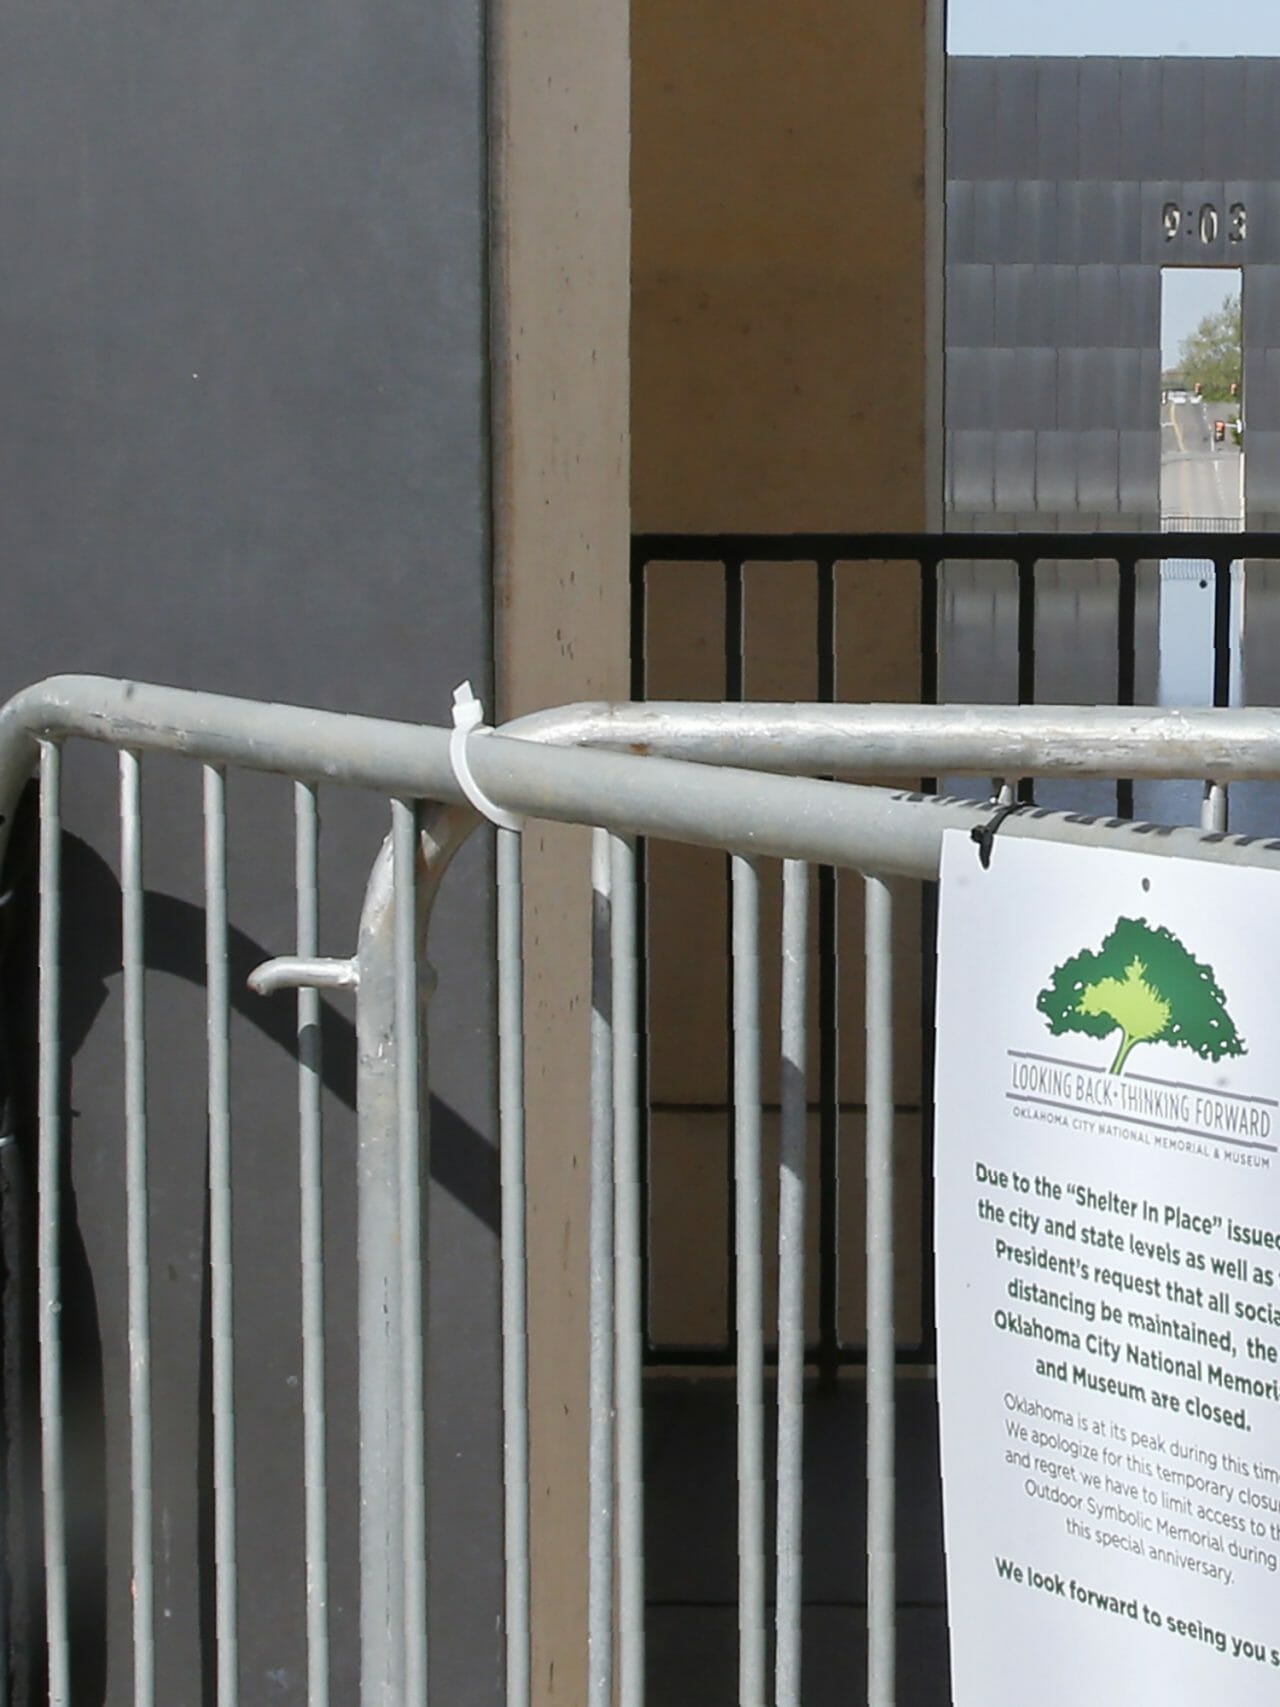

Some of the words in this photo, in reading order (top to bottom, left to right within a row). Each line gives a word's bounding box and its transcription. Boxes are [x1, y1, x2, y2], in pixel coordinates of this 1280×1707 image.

[1162, 202, 1247, 245] 9:03
[1013, 1062, 1071, 1099] LOOKING
[1196, 1098, 1270, 1138] FORWARD
[1013, 1106, 1068, 1126] OKLAHOMA
[1073, 1118, 1095, 1131] CITY
[1099, 1125, 1150, 1144] NATIONAL
[1155, 1136, 1209, 1157] MEMORIAL
[1214, 1148, 1219, 1159] &
[1224, 1150, 1269, 1168] MUSEUM
[976, 1162, 1009, 1189] Due
[1012, 1171, 1030, 1194] to
[1034, 1176, 1062, 1200] the
[1143, 1200, 1159, 1224] In
[978, 1198, 1005, 1224] the
[1009, 1207, 1040, 1235] city
[1044, 1218, 1076, 1241] and
[1080, 1226, 1124, 1252] state
[1129, 1233, 1181, 1266] levels
[1185, 1251, 1206, 1271] as
[1210, 1257, 1248, 1282] well
[1252, 1266, 1274, 1287] as
[1008, 1277, 1096, 1322] distancing
[1101, 1300, 1123, 1324] be
[1127, 1311, 1237, 1358] maintained,
[1246, 1336, 1278, 1363] the
[1094, 1267, 1161, 1298] request
[1166, 1281, 1203, 1308] that
[1208, 1291, 1230, 1315] all
[994, 1309, 1081, 1350] Oklahoma
[1085, 1333, 1121, 1363] City
[1126, 1342, 1202, 1382] National
[1036, 1358, 1068, 1382] and
[1072, 1364, 1146, 1403] Museum
[1151, 1390, 1180, 1413] are
[1185, 1396, 1251, 1432] closed.
[1004, 1393, 1073, 1427] Oklahoma
[1078, 1412, 1088, 1431] is
[1092, 1421, 1106, 1437] at
[1111, 1421, 1127, 1442] its
[1131, 1432, 1166, 1453] peak
[1170, 1440, 1217, 1471] during
[1222, 1454, 1250, 1477] this
[1005, 1419, 1028, 1442] We
[1031, 1429, 1098, 1462] apologize
[1102, 1447, 1123, 1467] for
[1126, 1454, 1153, 1477] this
[1156, 1463, 1234, 1503] temporary
[1005, 1450, 1031, 1469] and
[1034, 1457, 1077, 1482] regret
[1079, 1472, 1101, 1490] we
[1105, 1475, 1138, 1499] have
[1142, 1486, 1157, 1505] to
[1162, 1490, 1193, 1516] limit
[1197, 1505, 1246, 1532] access
[1250, 1517, 1266, 1537] to
[1025, 1479, 1083, 1510] Outdoor
[1087, 1496, 1152, 1531] Symbolic
[1156, 1517, 1225, 1553] Memorial
[1227, 1539, 1277, 1572] during
[1066, 1518, 1091, 1540] this
[1095, 1530, 1145, 1555] special
[1149, 1546, 1234, 1585] anniversary.
[995, 1557, 1023, 1583] We
[1027, 1566, 1066, 1597] look
[1069, 1579, 1138, 1620] forward
[1142, 1604, 1162, 1627] to
[1166, 1616, 1227, 1652] seeing
[1231, 1636, 1266, 1662] you
